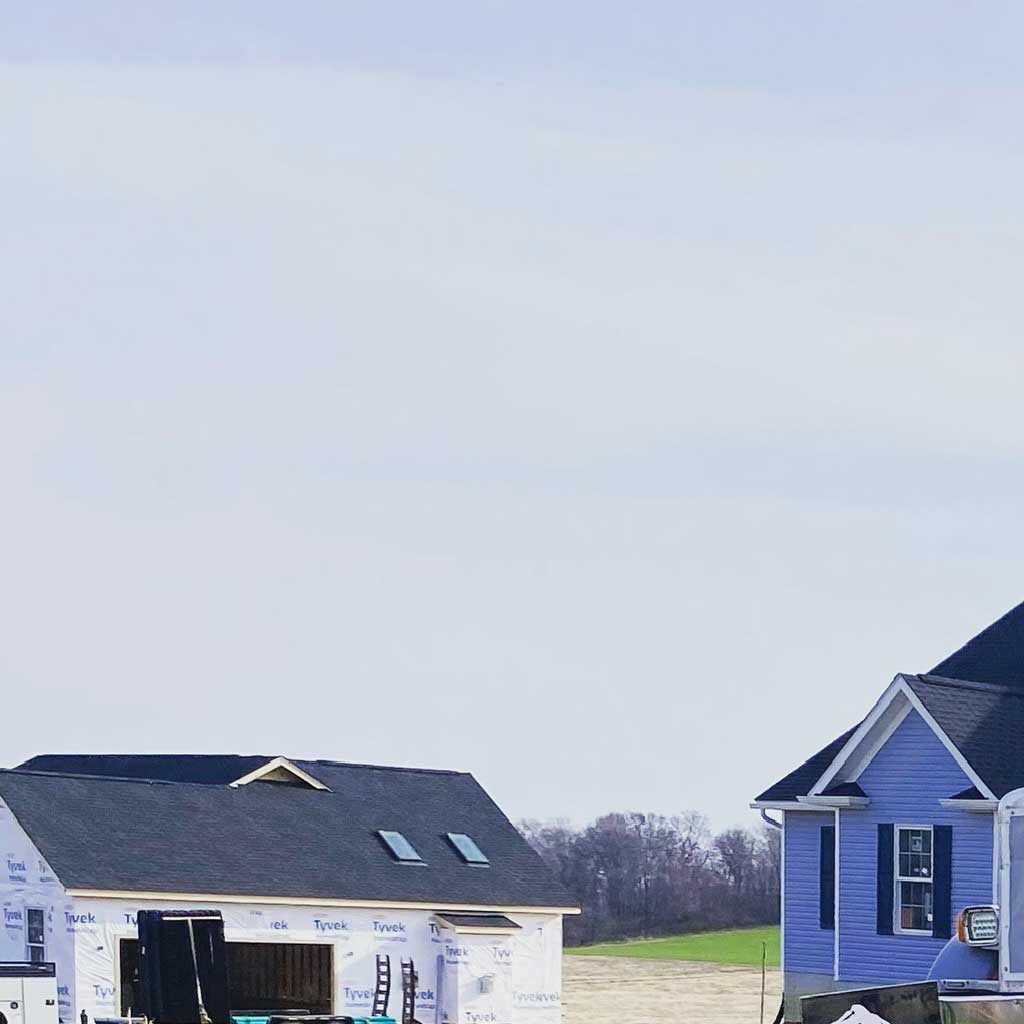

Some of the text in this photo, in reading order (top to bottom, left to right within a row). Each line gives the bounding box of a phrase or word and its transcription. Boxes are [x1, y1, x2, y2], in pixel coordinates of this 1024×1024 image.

[314, 919, 348, 932] Tyvek
[373, 921, 406, 933] Tyvek
[416, 989, 434, 1000] vek
[466, 1011, 497, 1023] Tyvek
